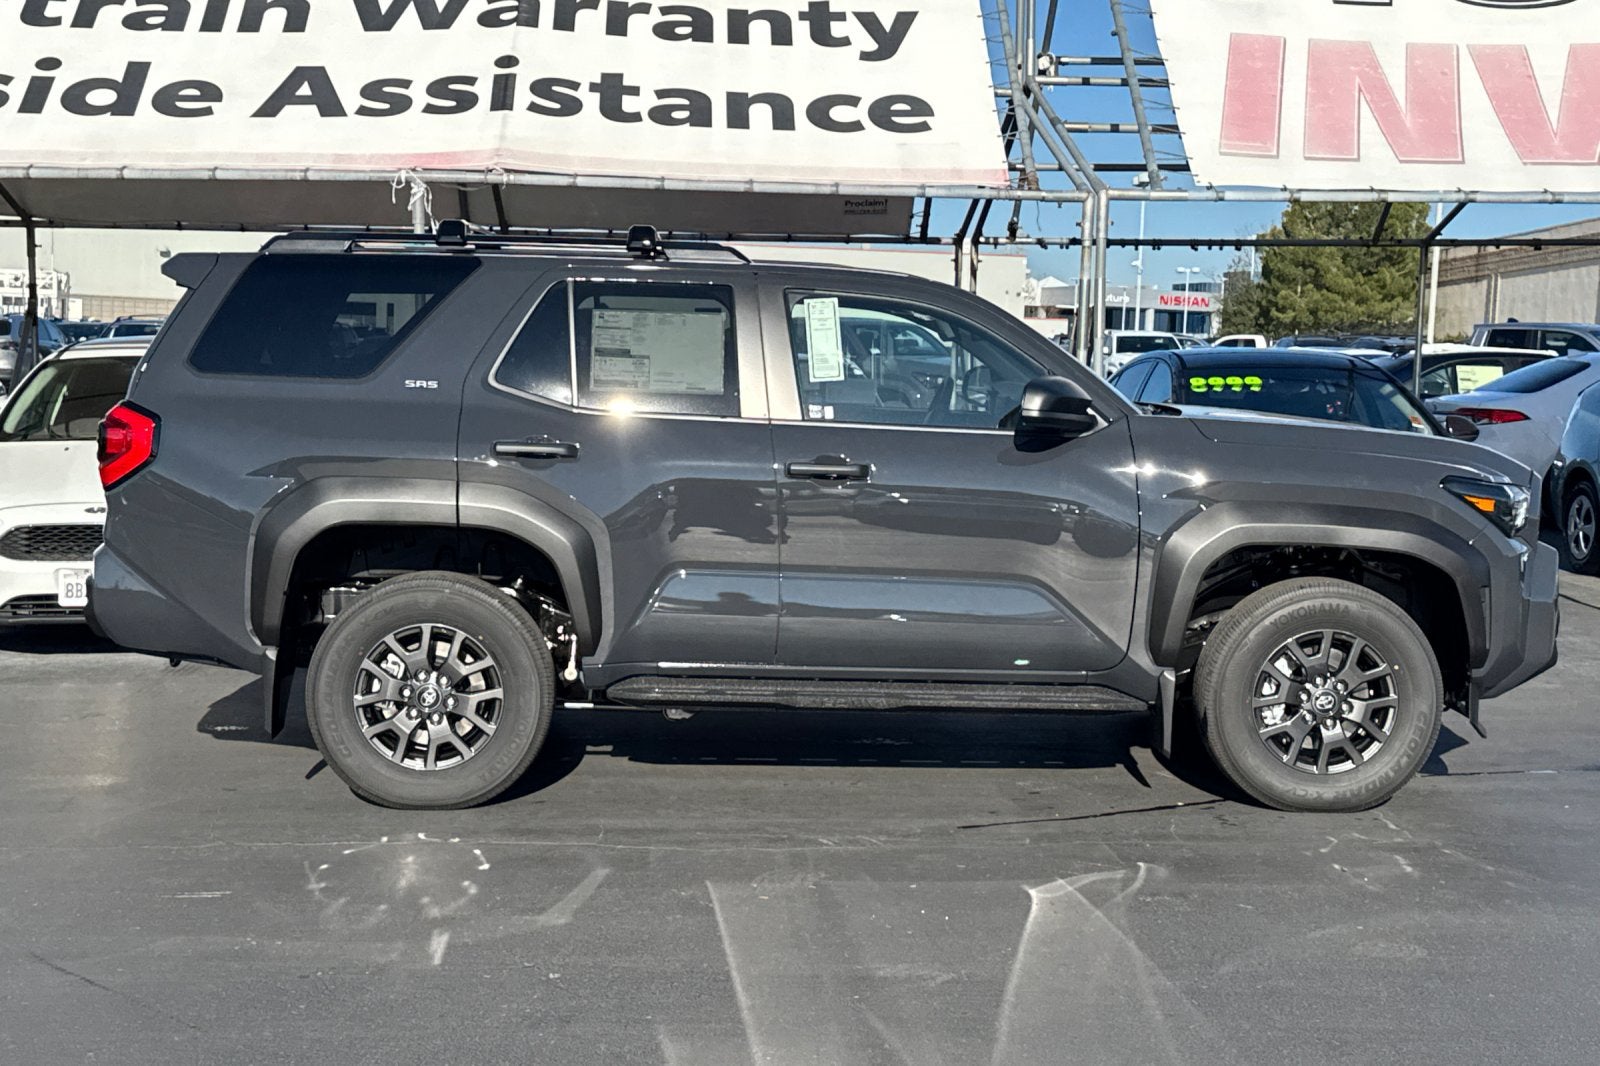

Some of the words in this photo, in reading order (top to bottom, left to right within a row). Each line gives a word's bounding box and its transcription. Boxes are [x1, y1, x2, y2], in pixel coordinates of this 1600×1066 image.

[354, 0, 919, 62] Warranty
[0, 56, 223, 118] ide
[249, 54, 935, 134] Assistance
[1219, 32, 1600, 165] INV
[1159, 295, 1210, 308] NISSAN
[65, 582, 84, 599] 8B
[1269, 603, 1351, 628] YOKOHAMA
